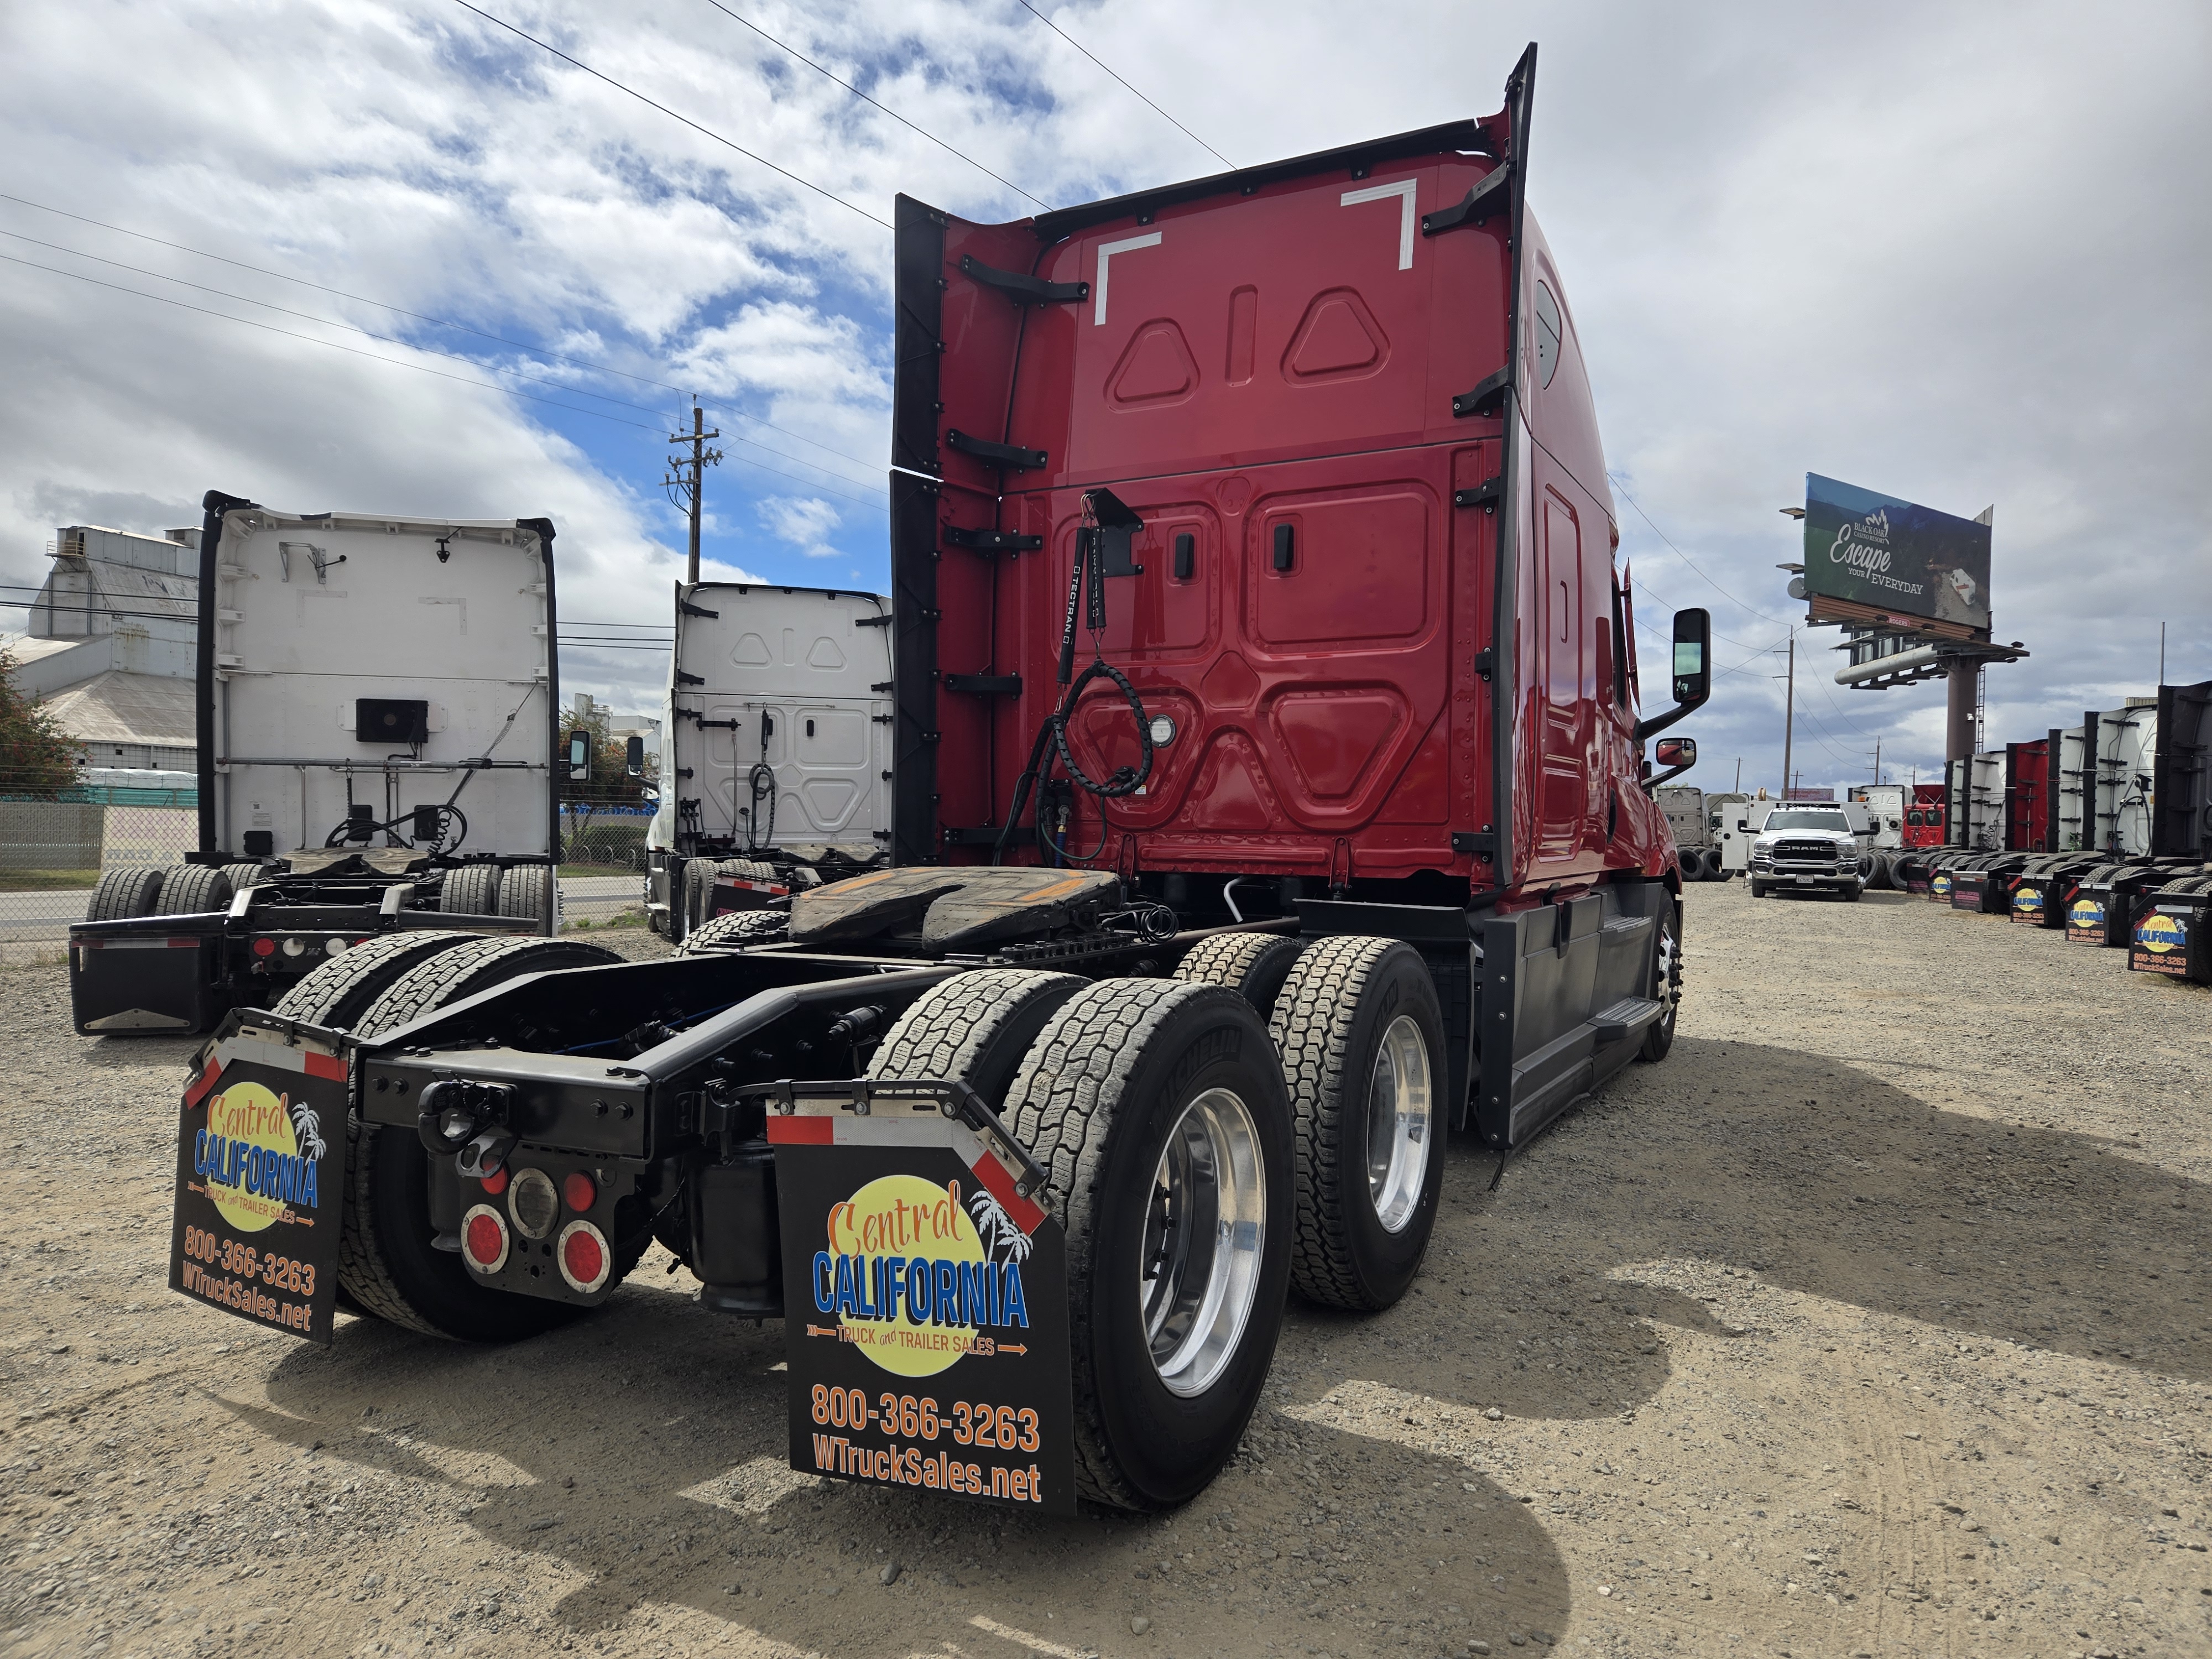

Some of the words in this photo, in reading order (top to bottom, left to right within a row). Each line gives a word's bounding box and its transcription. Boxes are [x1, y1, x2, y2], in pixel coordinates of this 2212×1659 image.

[1830, 523, 1891, 579] Escape
[1854, 522, 1872, 535] BLACK
[1873, 527, 1886, 538] OAK
[1854, 531, 1869, 540] CASINO
[1870, 535, 1885, 544] RESORT
[1848, 567, 1865, 577] YOUR
[1871, 573, 1923, 594] EVERYDAY
[1065, 577, 1078, 633] TECTRAN
[1888, 617, 1908, 627] ROGERS
[2069, 928, 2104, 937] 800-366-3263
[2070, 910, 2104, 921] CALIFORNIA
[2137, 928, 2186, 945] CALIFORNIA
[2133, 962, 2186, 975] WTruckSales.net
[2134, 953, 2187, 966] 800-366-3263
[1151, 1030, 1241, 1139] MICHELIN
[207, 1093, 288, 1139] Central
[195, 1128, 318, 1208] CALIFORNIA
[204, 1185, 226, 1204] TRUCK
[228, 1192, 238, 1206] and
[239, 1197, 268, 1217] TRAILER
[270, 1206, 295, 1224] SALES
[828, 1179, 963, 1259] Central
[184, 1225, 316, 1297] 800-366-3263
[182, 1260, 312, 1332] WTruckSales.net
[812, 1250, 1030, 1328] CALIFORNIA
[837, 1325, 875, 1344] TRUCK
[880, 1326, 896, 1346] and
[899, 1331, 949, 1352] TRAILER
[952, 1335, 995, 1357] SALES
[811, 1384, 1041, 1453] 800-366-3263
[812, 1432, 1042, 1503] WTruckSales.net
